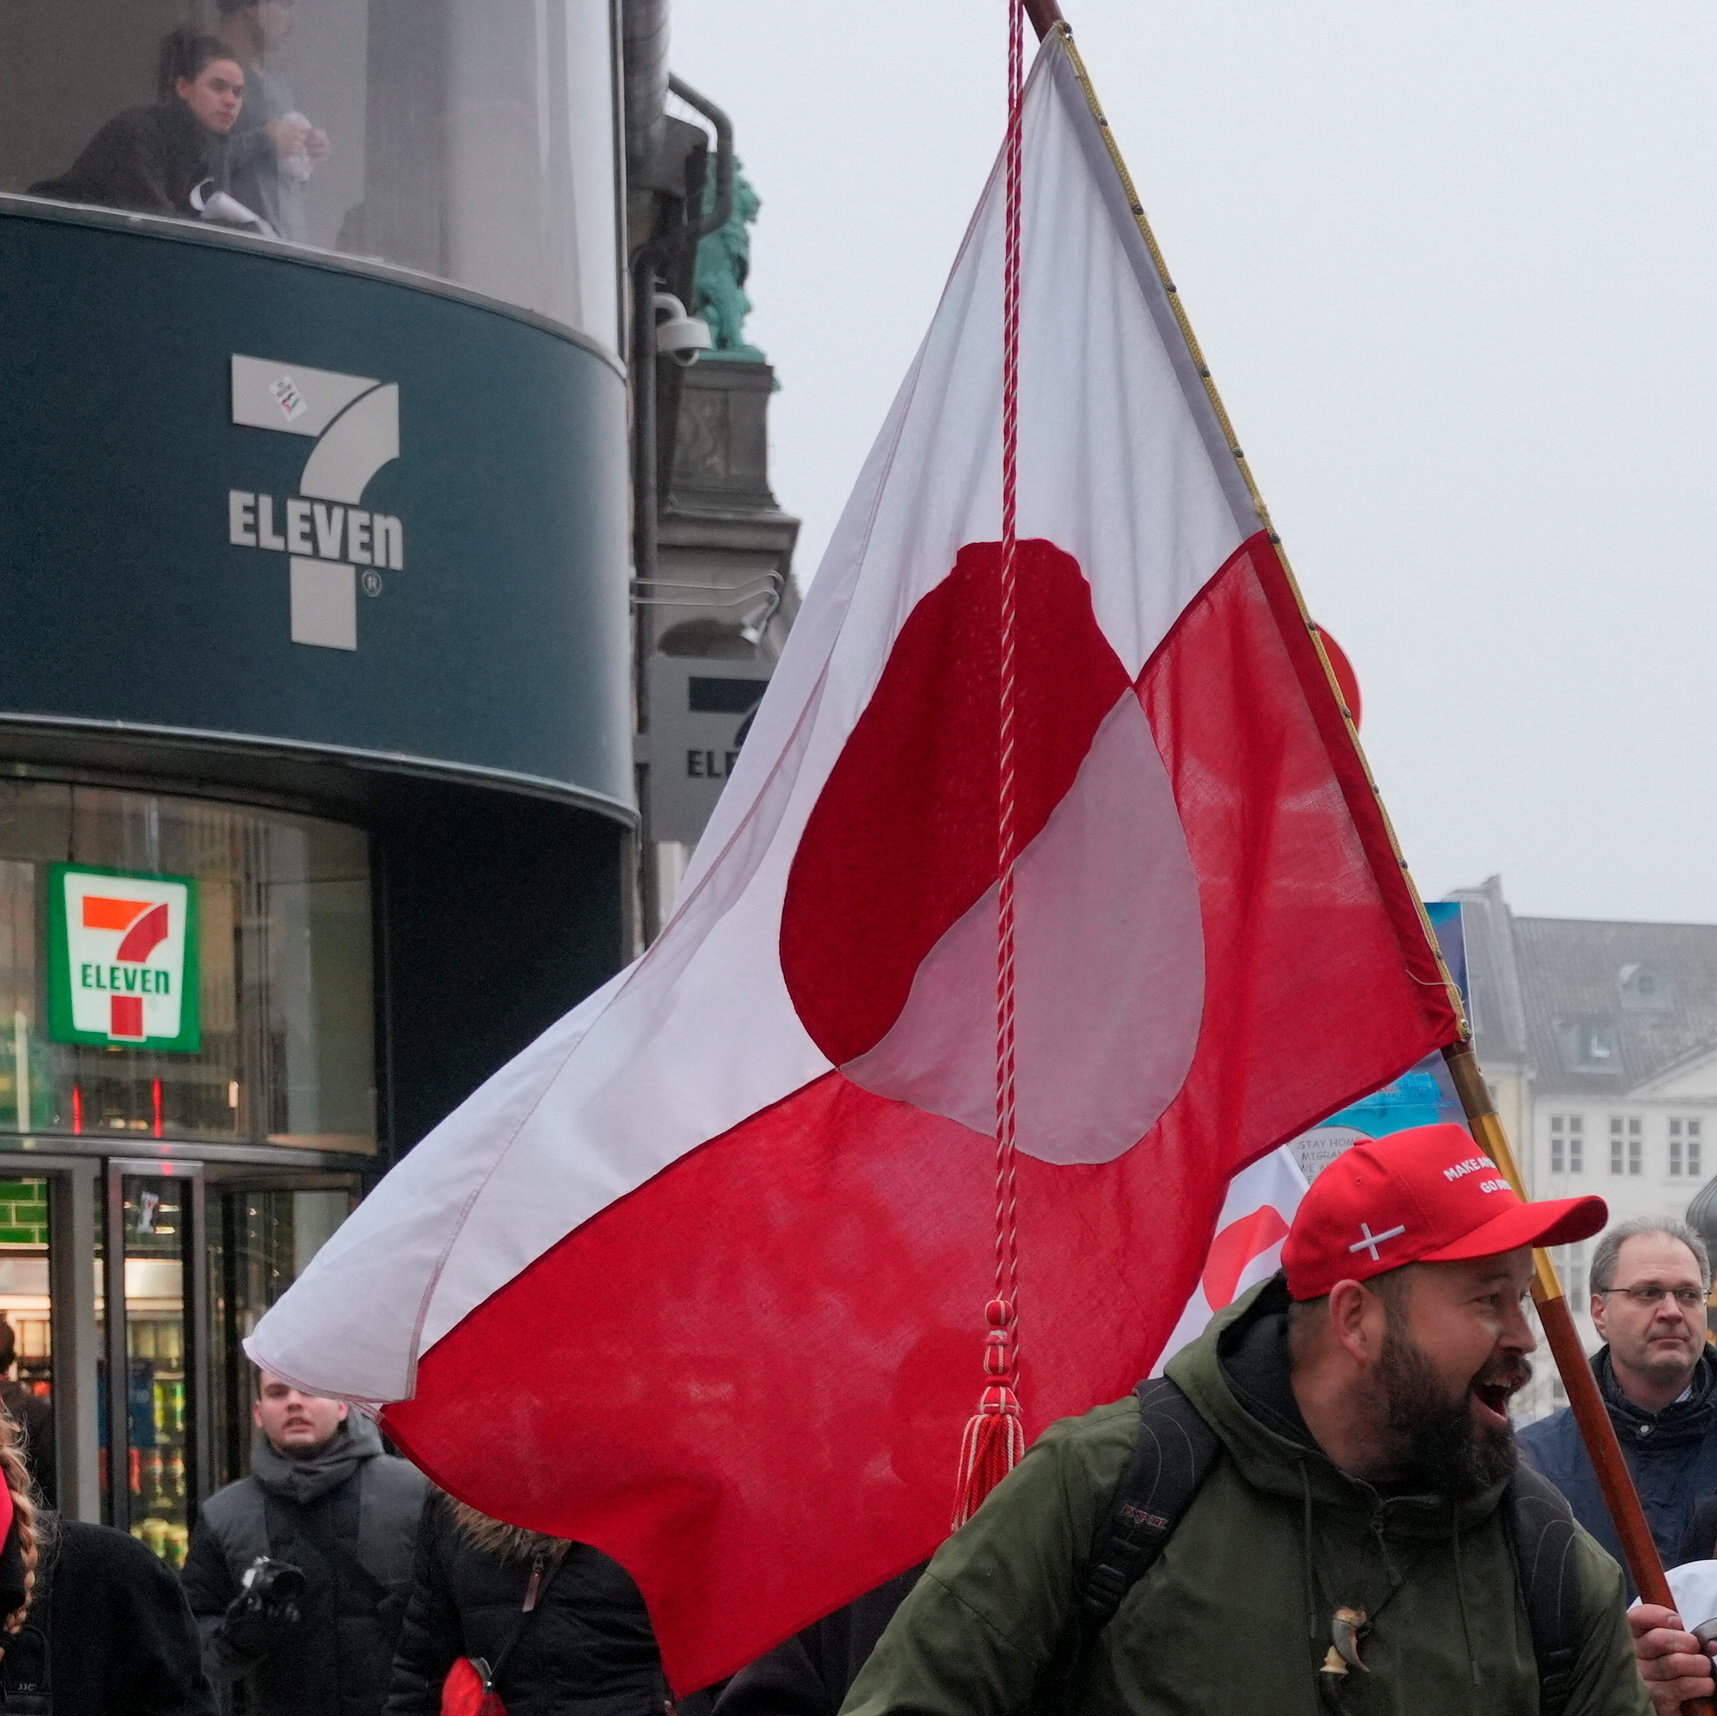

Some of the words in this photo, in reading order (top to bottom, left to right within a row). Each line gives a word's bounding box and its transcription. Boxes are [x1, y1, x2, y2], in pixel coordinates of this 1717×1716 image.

[231, 353, 400, 651] 7
[83, 896, 169, 1037] 7
[1298, 1140, 1326, 1150] STAY
[1443, 1158, 1480, 1182] MAKE
[1480, 1180, 1498, 1193] GO
